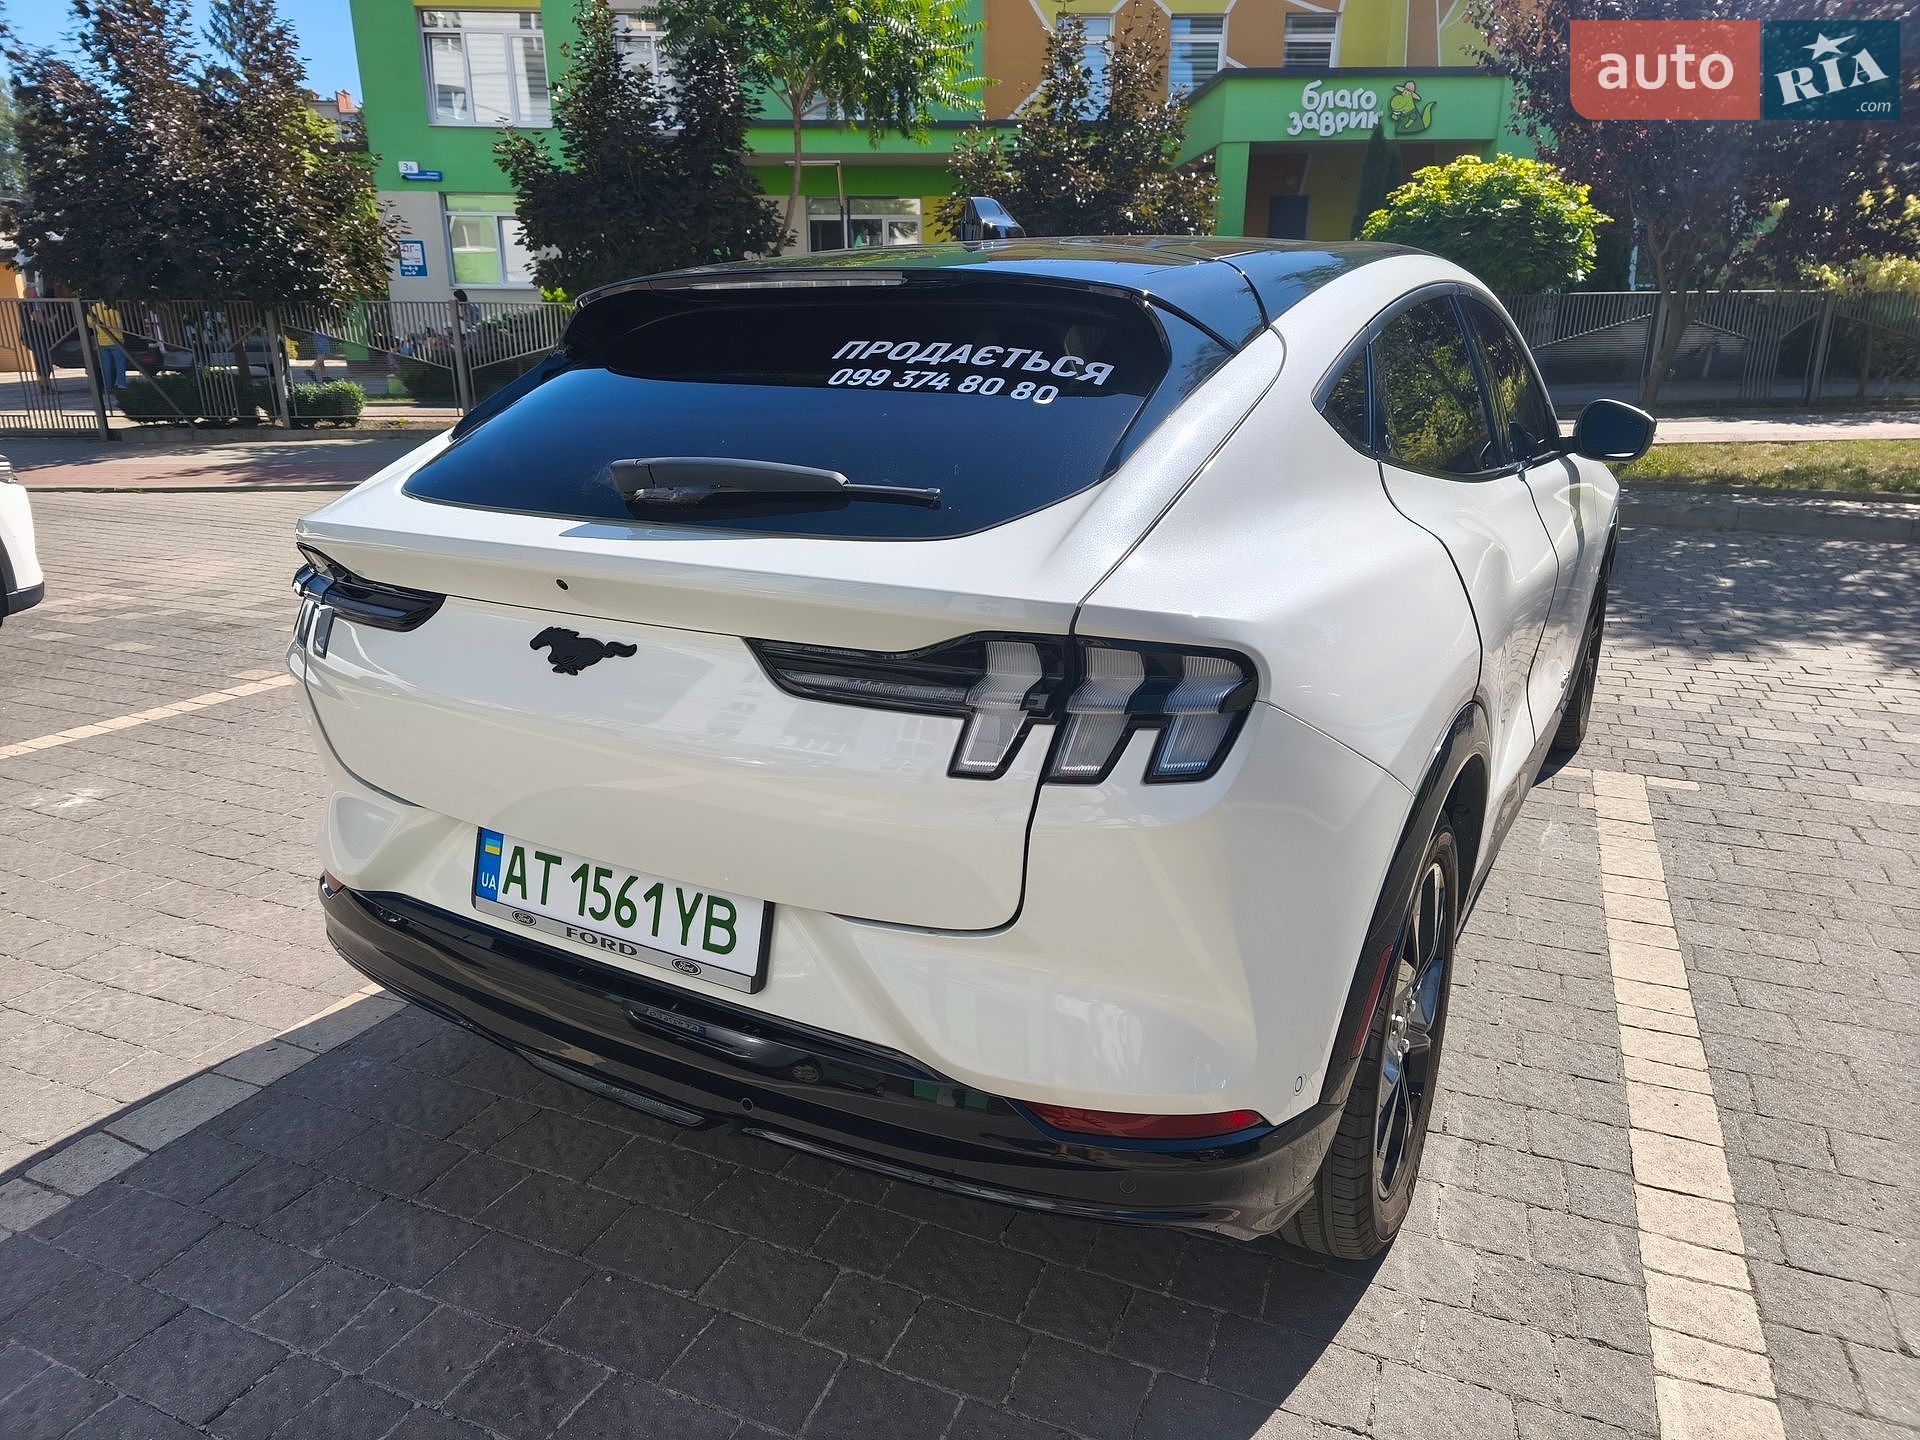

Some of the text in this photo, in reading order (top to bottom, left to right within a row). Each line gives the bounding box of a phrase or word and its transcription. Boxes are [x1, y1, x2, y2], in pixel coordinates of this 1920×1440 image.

[1301, 79, 1377, 115] благо
[831, 340, 1115, 386] ПРОДАЄТЬСЯ
[827, 368, 1059, 405] 099 374 80 80
[481, 871, 497, 890] UA
[502, 845, 737, 956] AT 1561 YB
[566, 926, 639, 957] FORD
